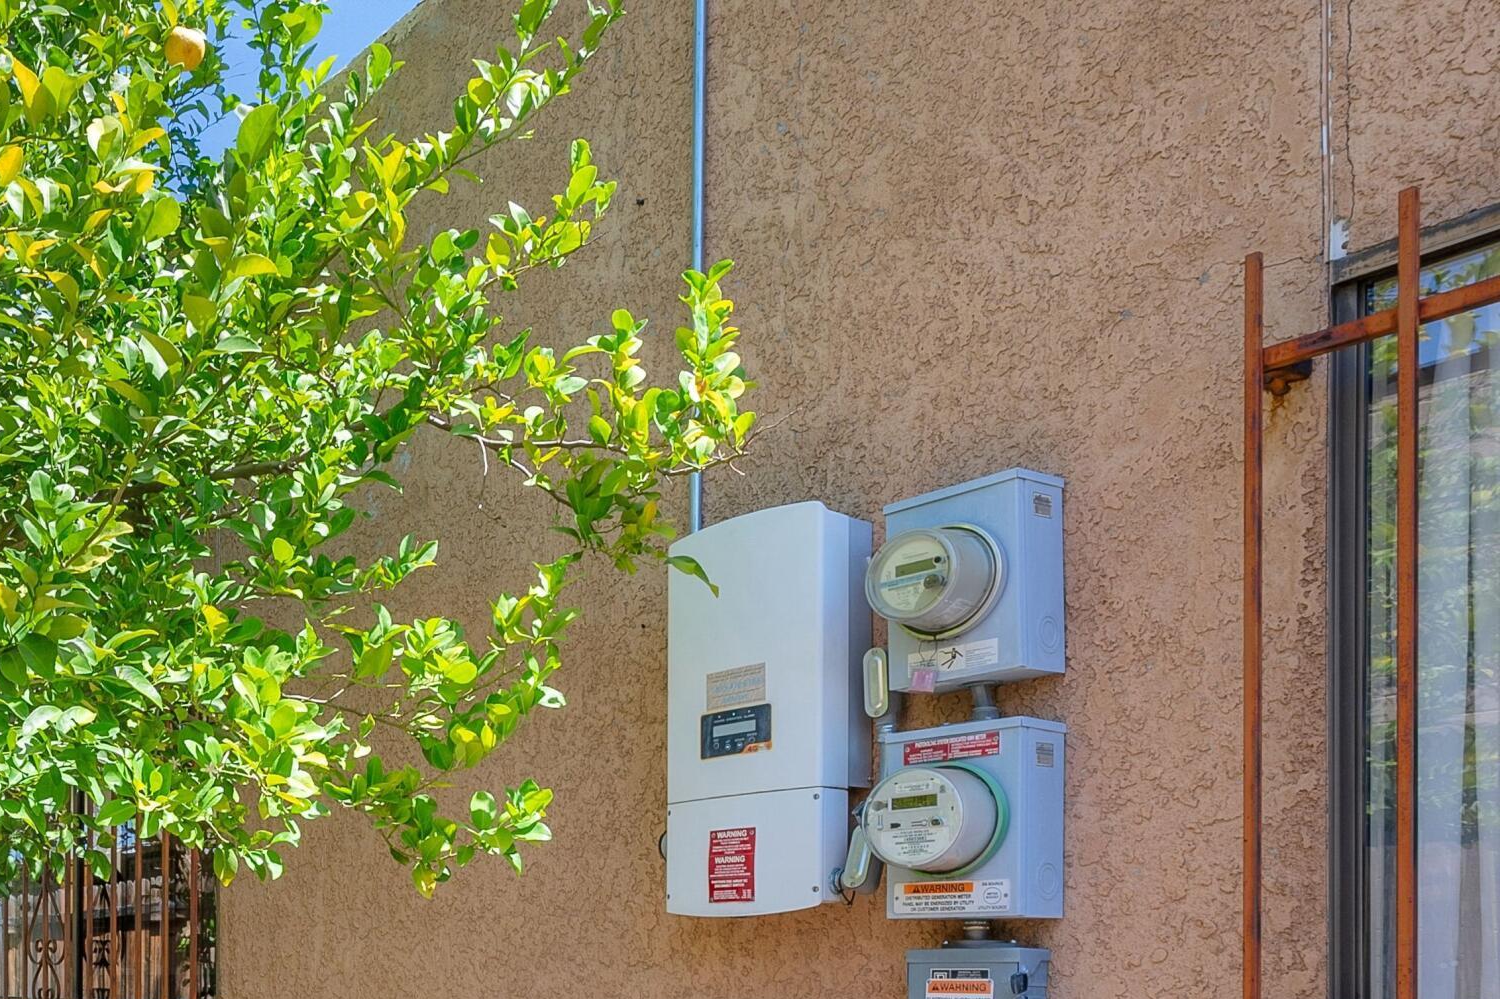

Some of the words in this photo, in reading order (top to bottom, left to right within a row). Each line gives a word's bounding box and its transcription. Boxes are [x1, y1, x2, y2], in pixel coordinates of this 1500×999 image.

[716, 829, 747, 839] WARNING
[714, 855, 746, 864] WARNING
[920, 884, 964, 893] WARNING
[940, 982, 987, 992] WARNING
